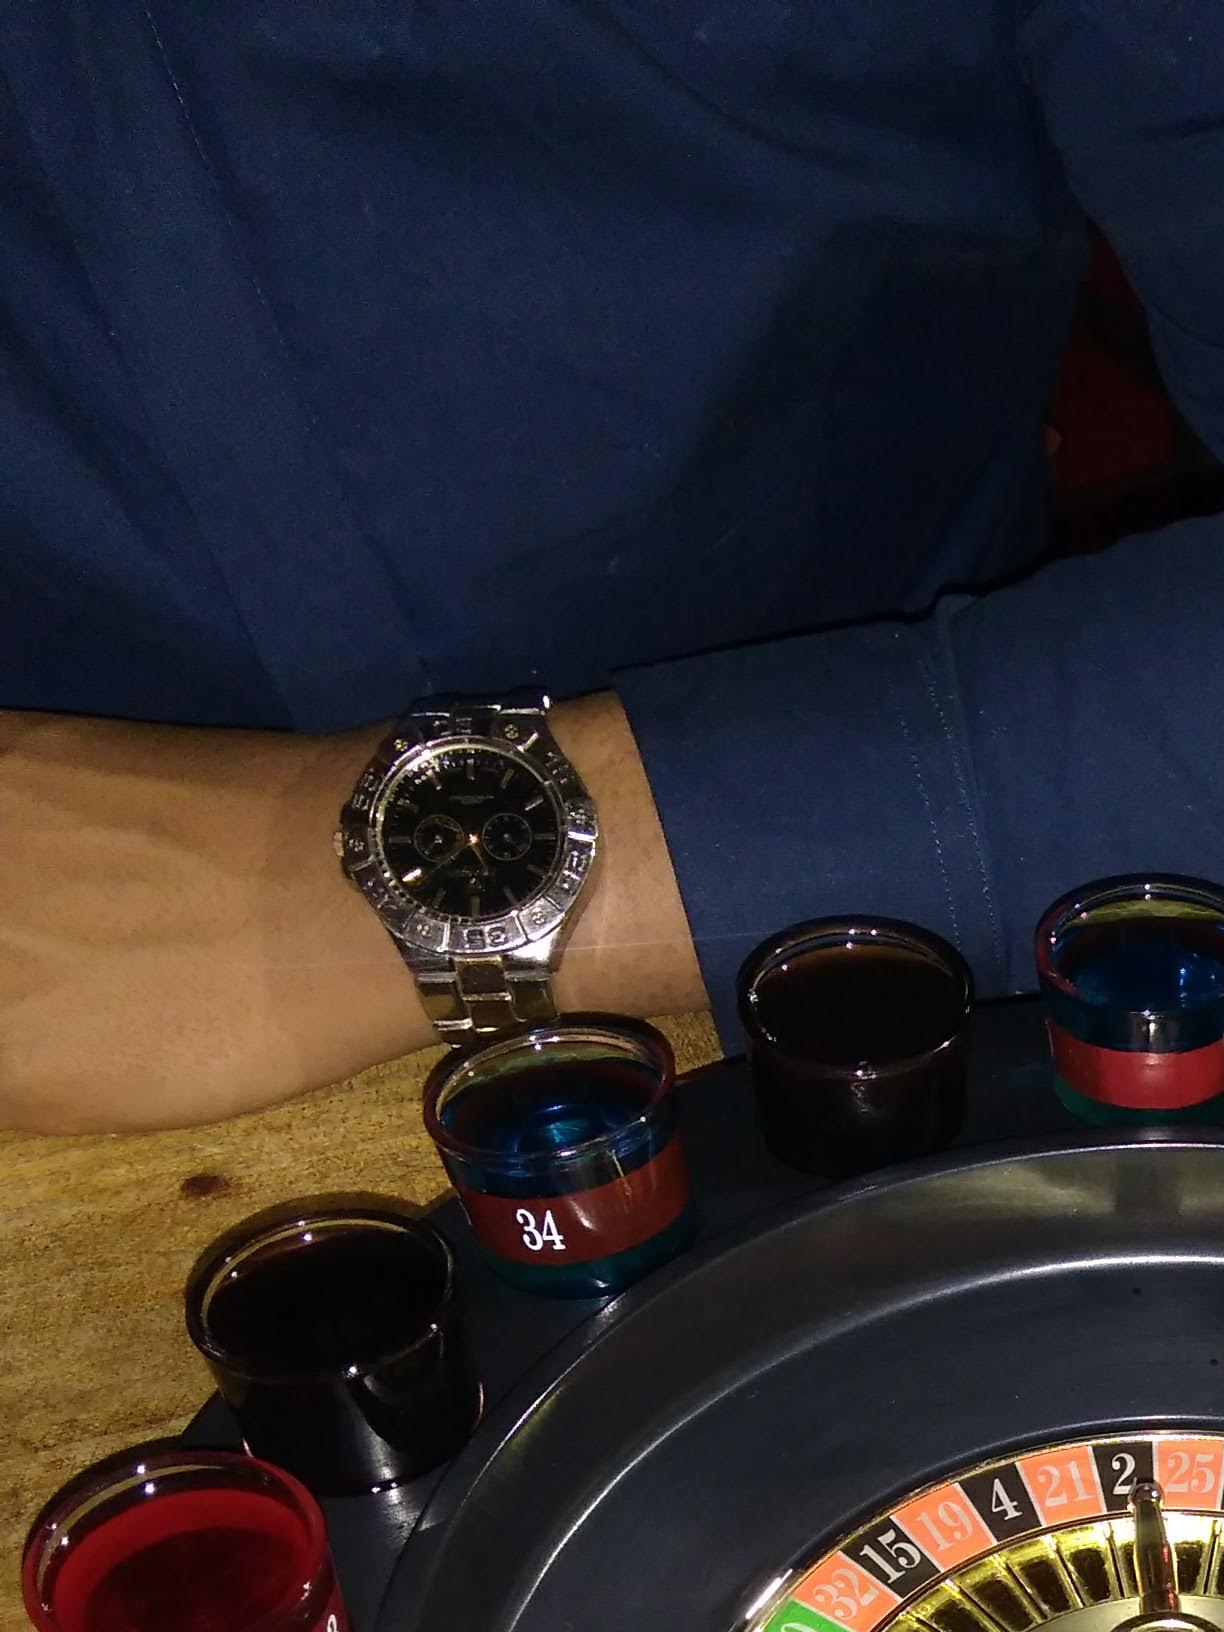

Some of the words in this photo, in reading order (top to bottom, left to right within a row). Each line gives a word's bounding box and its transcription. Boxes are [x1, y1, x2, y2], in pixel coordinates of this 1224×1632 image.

[516, 1208, 566, 1251] 34
[1037, 1461, 1093, 1508] 21
[1112, 1453, 1138, 1495] 2
[1164, 1452, 1215, 1493] 25
[990, 1479, 1023, 1521] 4
[915, 1500, 975, 1552] 19
[859, 1529, 922, 1584] 15
[813, 1567, 877, 1620] 32
